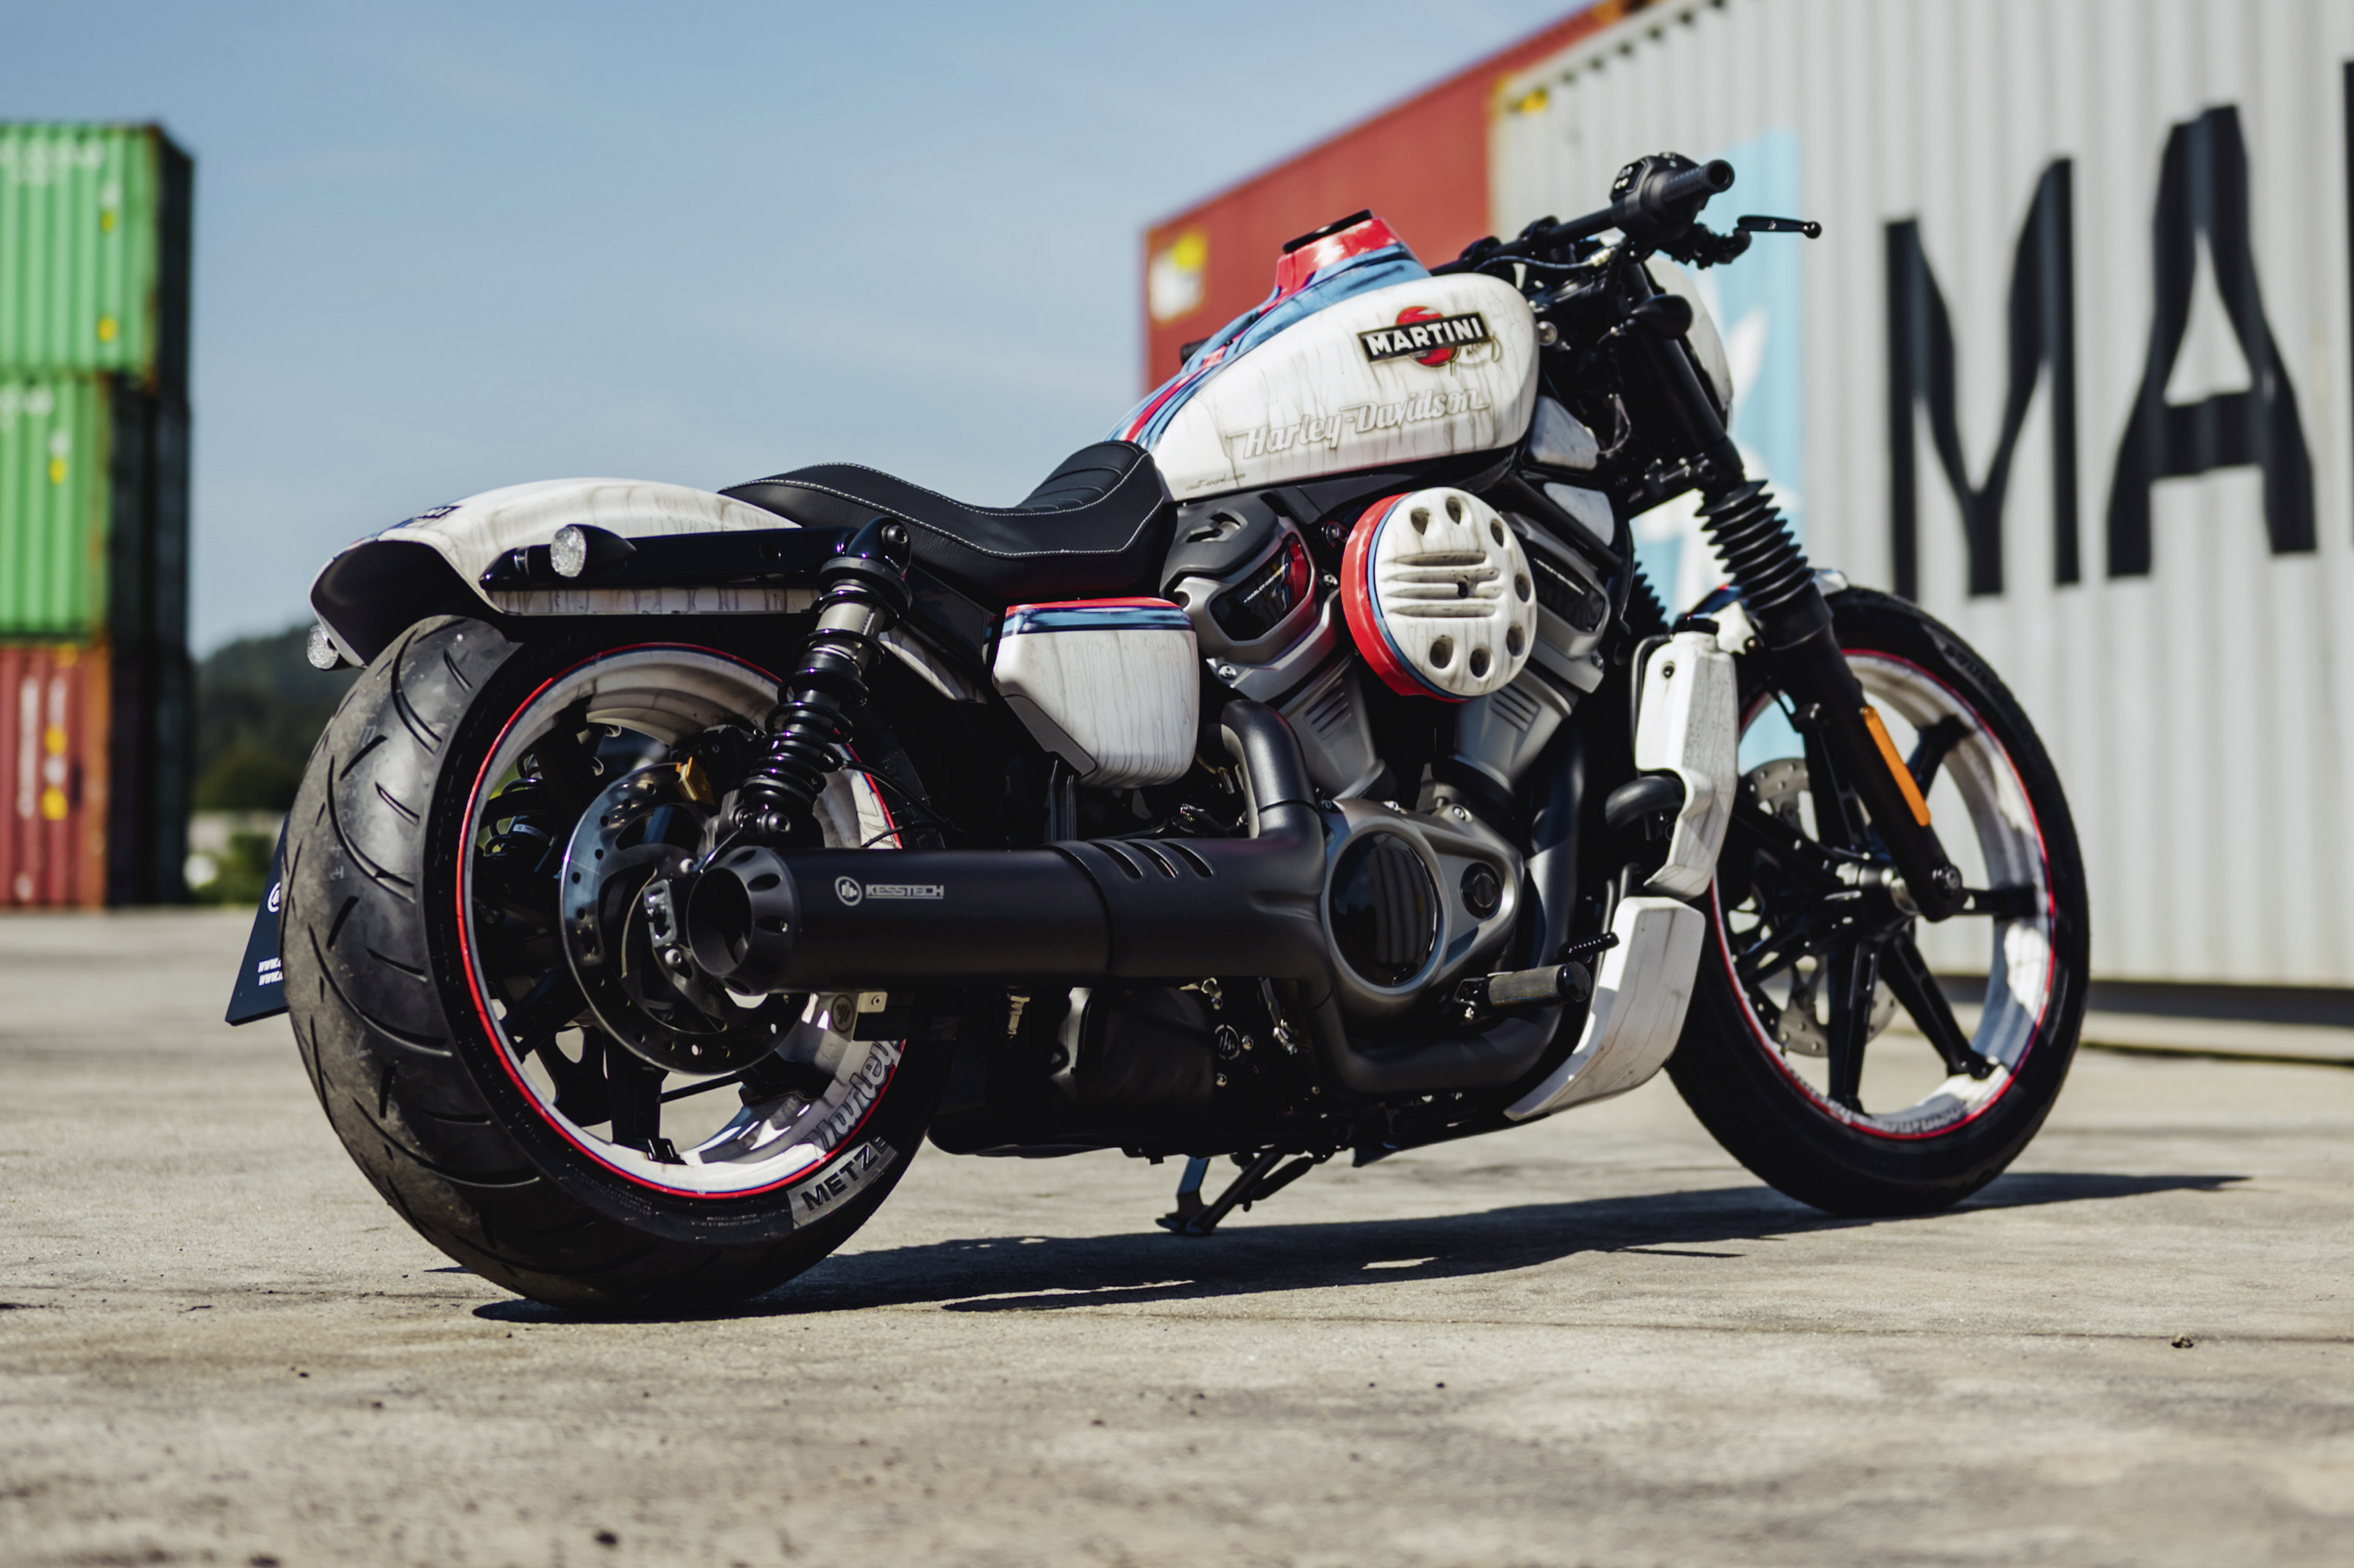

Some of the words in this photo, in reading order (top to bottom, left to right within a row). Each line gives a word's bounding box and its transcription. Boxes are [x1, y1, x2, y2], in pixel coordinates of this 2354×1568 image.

[1365, 318, 1484, 356] MARTINI
[1884, 58, 2354, 604] MA
[1226, 389, 1490, 459] Harley-Davidson
[866, 885, 944, 897] KESSTECH
